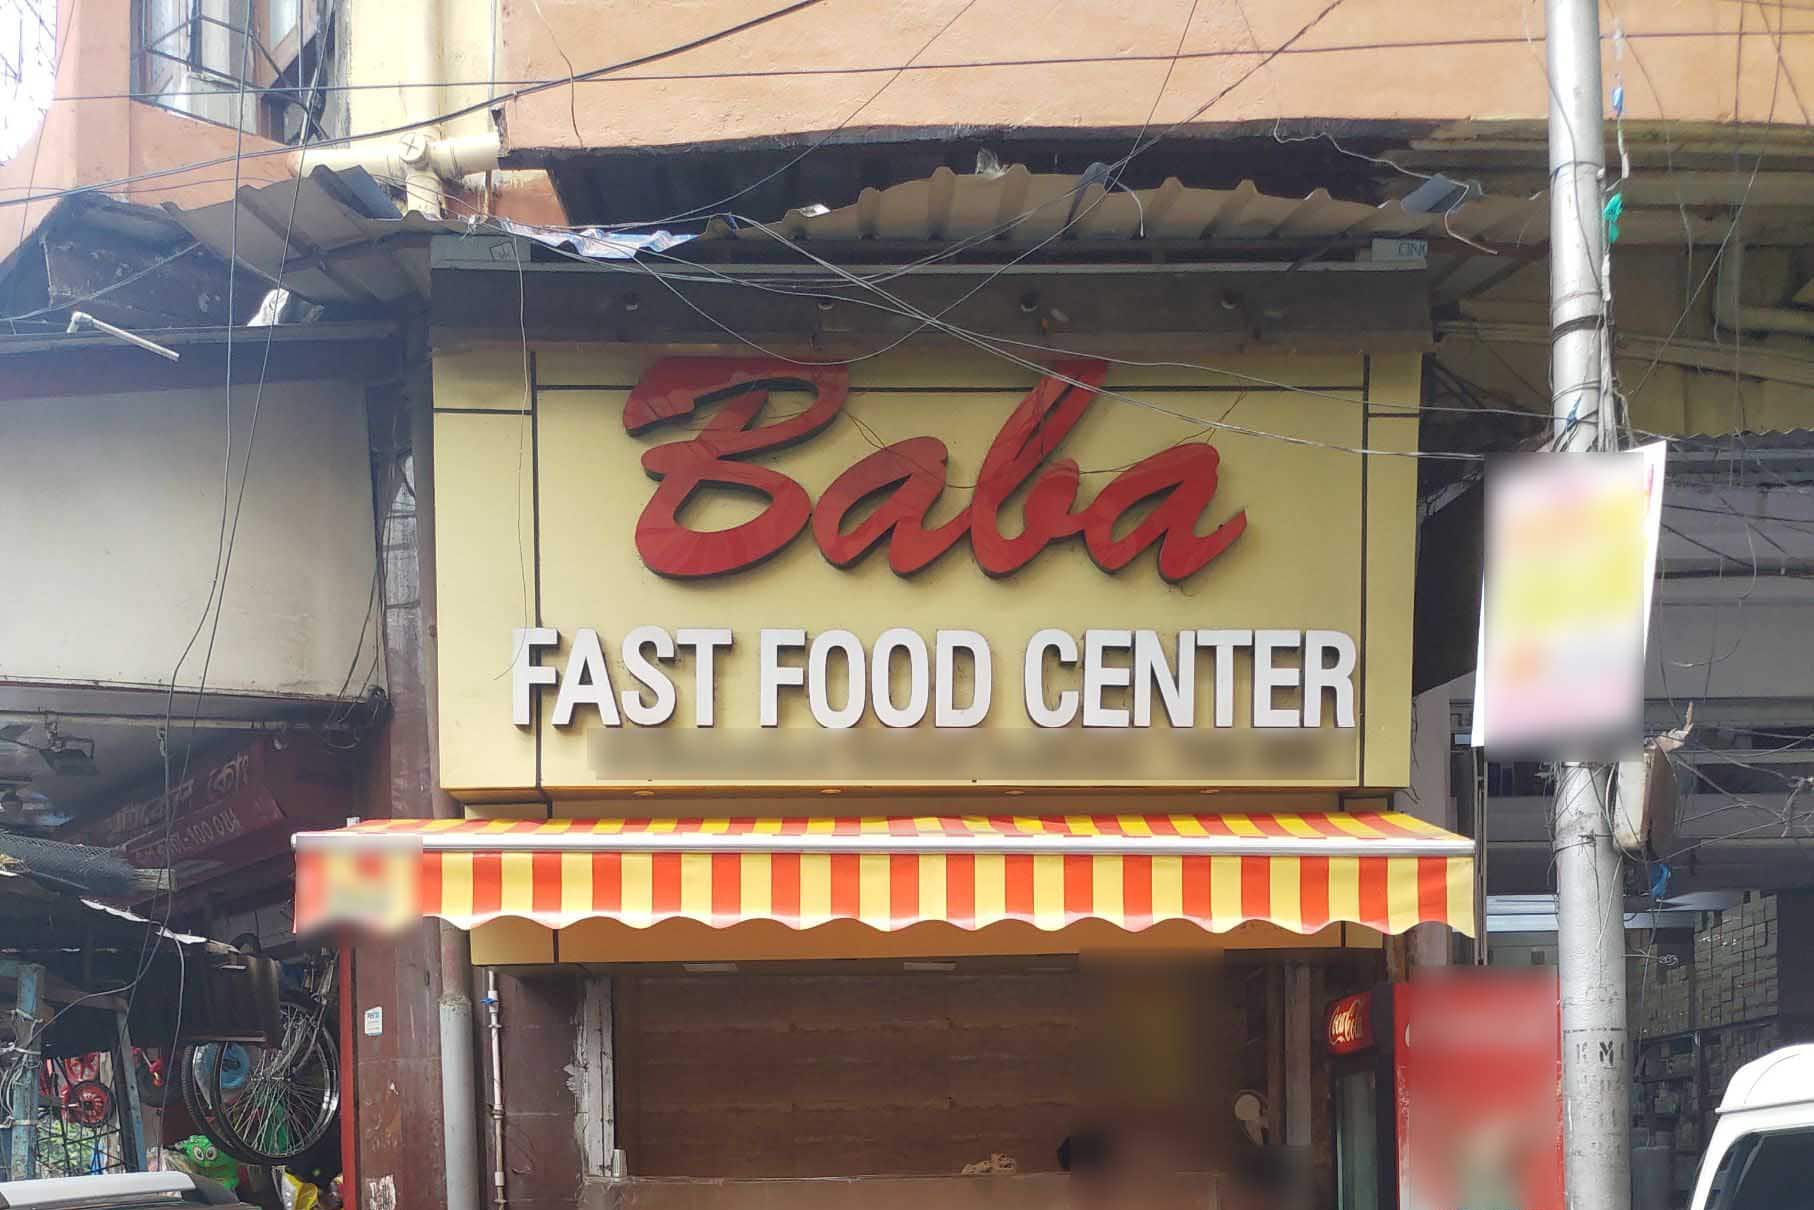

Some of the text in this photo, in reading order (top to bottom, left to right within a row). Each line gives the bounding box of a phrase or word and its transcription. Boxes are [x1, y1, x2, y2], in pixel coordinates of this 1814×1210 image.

[623, 356, 1248, 582] Baba
[511, 625, 1358, 729] FAST FOOD CENTER
